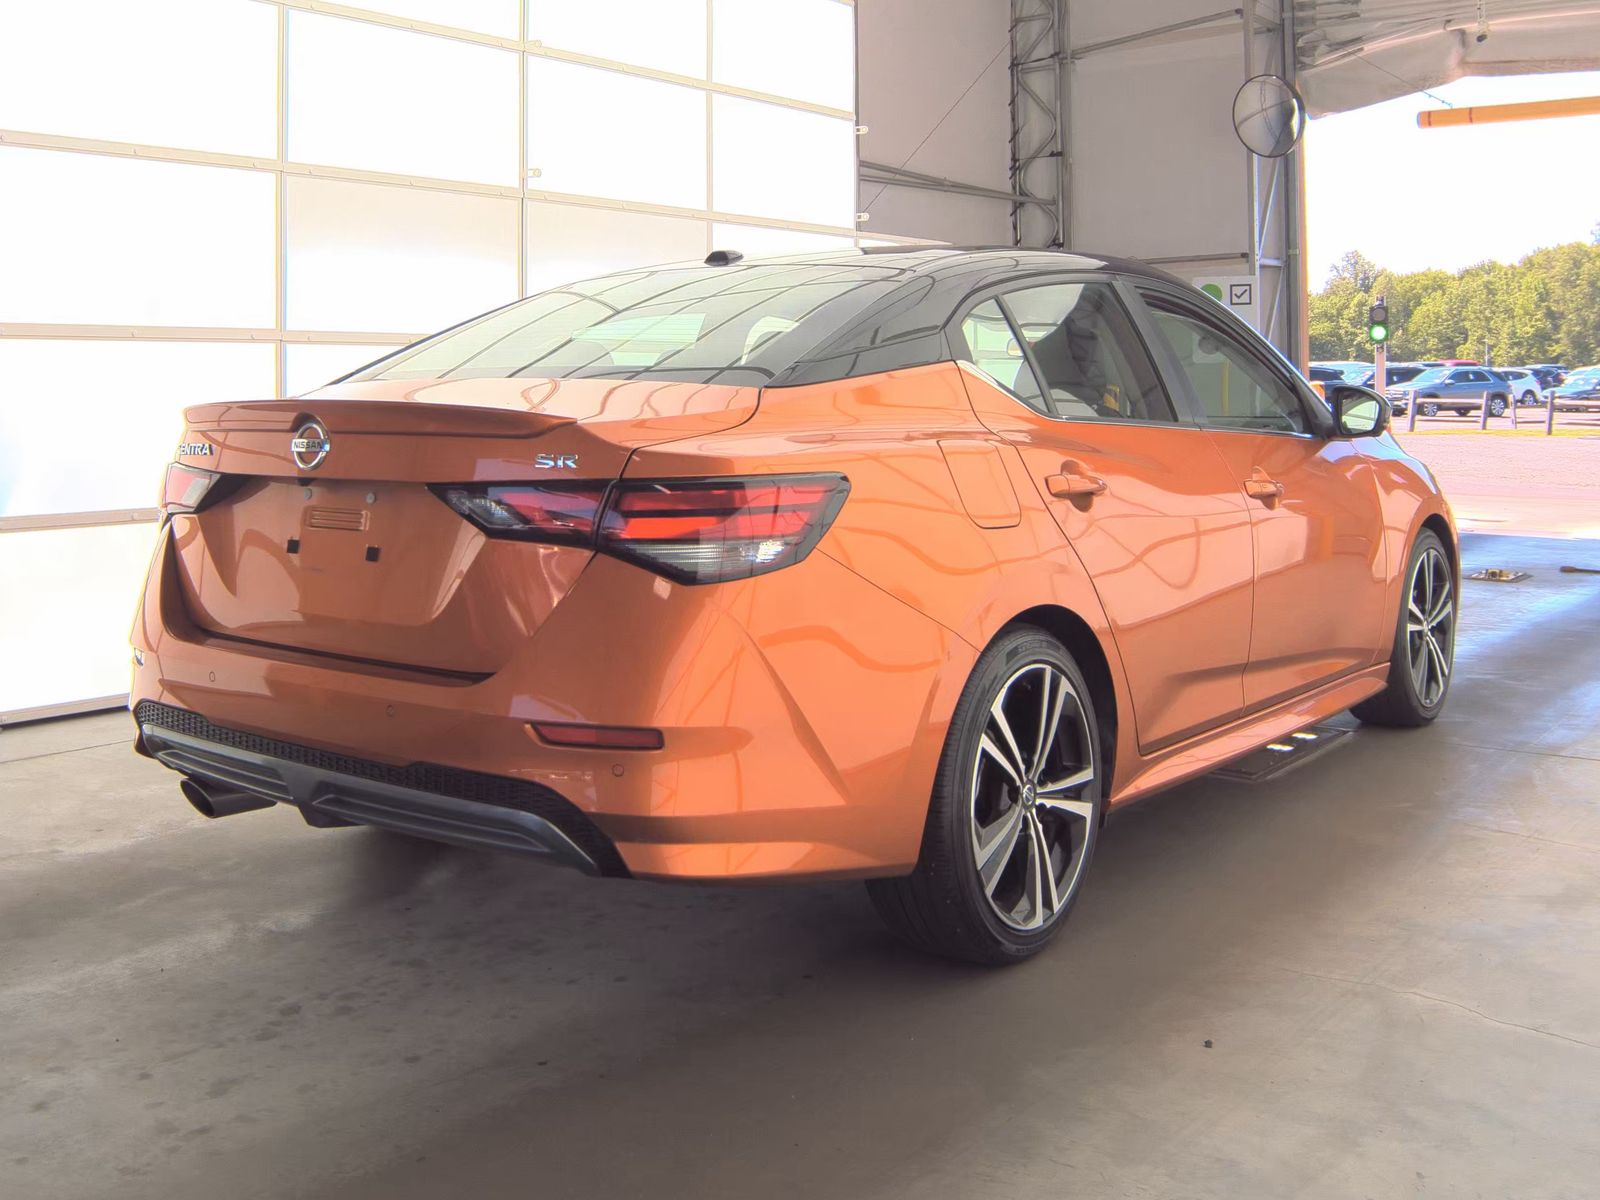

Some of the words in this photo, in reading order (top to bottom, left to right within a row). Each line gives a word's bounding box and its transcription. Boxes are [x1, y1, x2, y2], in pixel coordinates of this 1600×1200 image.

[178, 443, 213, 456] ENTRA
[293, 440, 323, 450] NISSAN
[535, 454, 578, 468] SR
